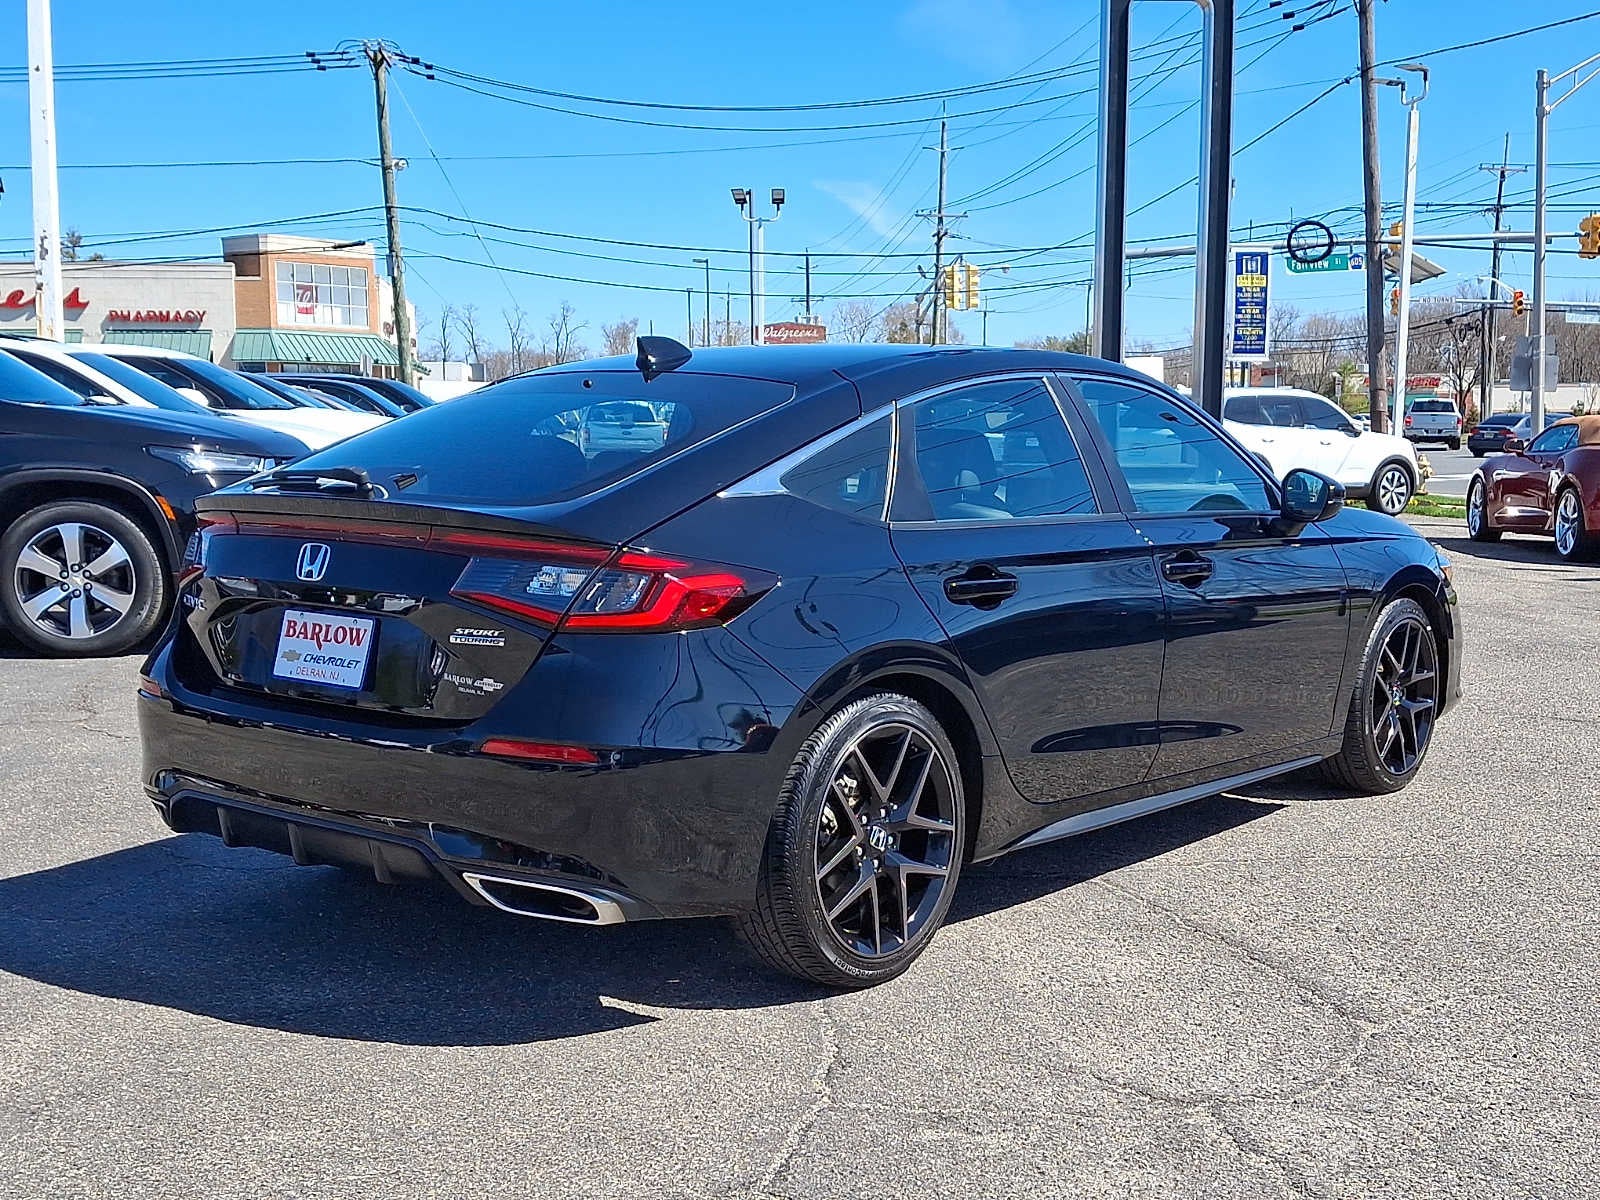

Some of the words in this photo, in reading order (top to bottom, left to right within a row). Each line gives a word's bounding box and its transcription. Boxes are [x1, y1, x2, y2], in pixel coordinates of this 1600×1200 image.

[1351, 256, 1363, 265] 605
[108, 309, 207, 323] PHARMACY
[764, 326, 819, 341] Walgreens
[285, 619, 368, 651] BARLOW
[455, 627, 505, 637] SPORT
[452, 636, 504, 647] TOURING
[303, 653, 361, 669] CHEVROLET
